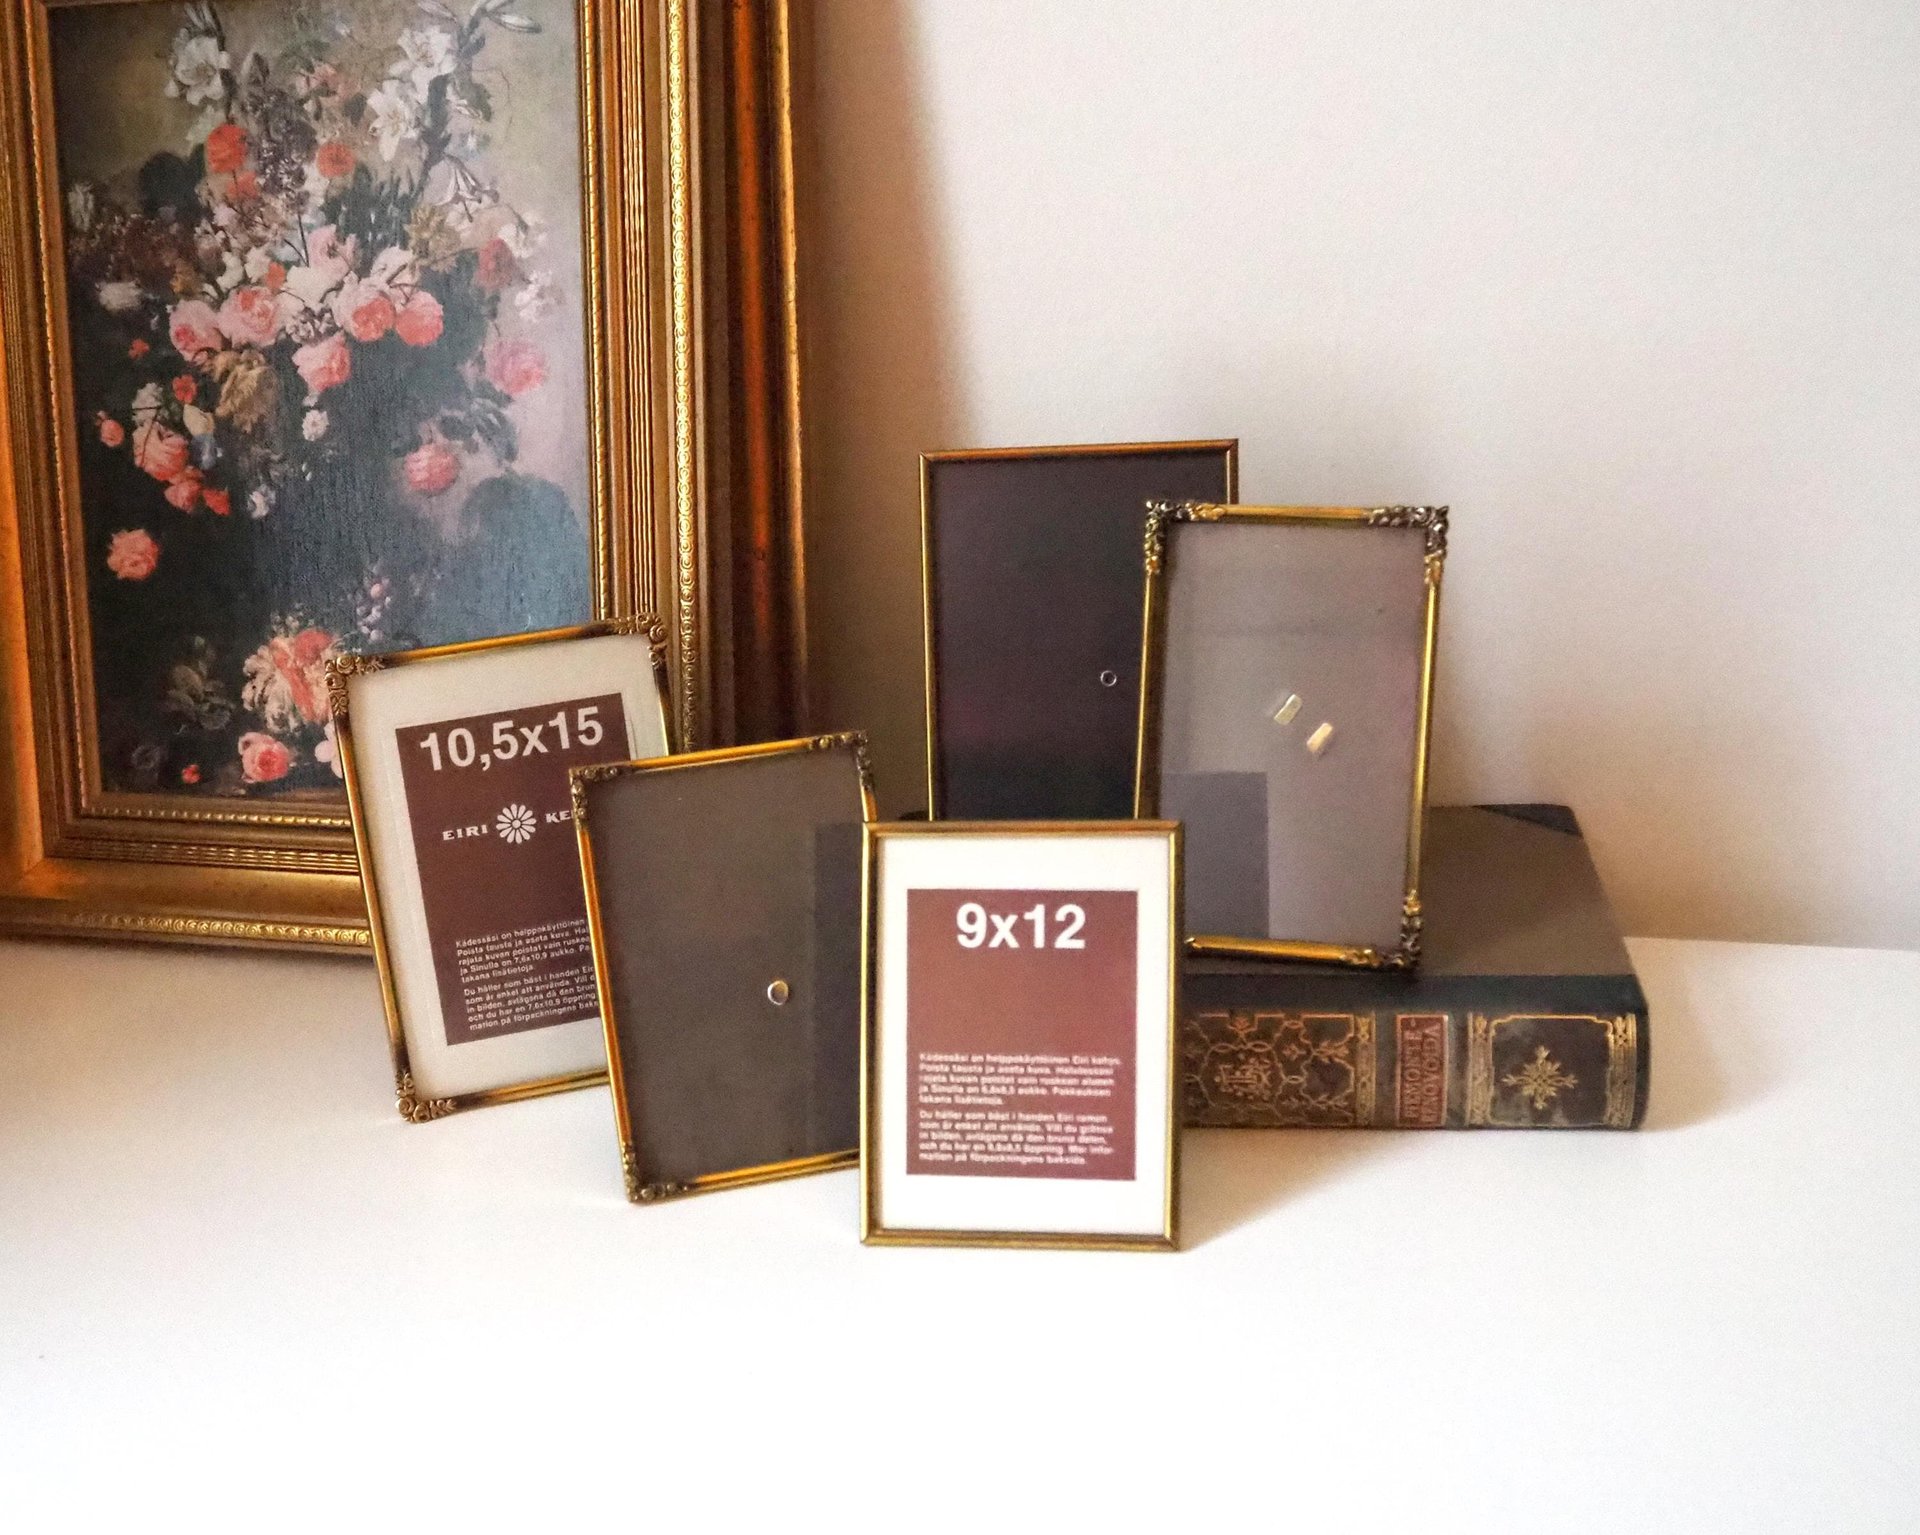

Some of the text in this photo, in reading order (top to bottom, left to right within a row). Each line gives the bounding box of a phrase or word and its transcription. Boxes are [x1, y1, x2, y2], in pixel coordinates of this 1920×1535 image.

[420, 706, 603, 771] 10,5x15
[442, 824, 489, 841] EIRI
[956, 902, 1086, 949] 9x12
[457, 947, 483, 956] Poista
[460, 968, 468, 976] ja
[468, 1014, 483, 1022] och
